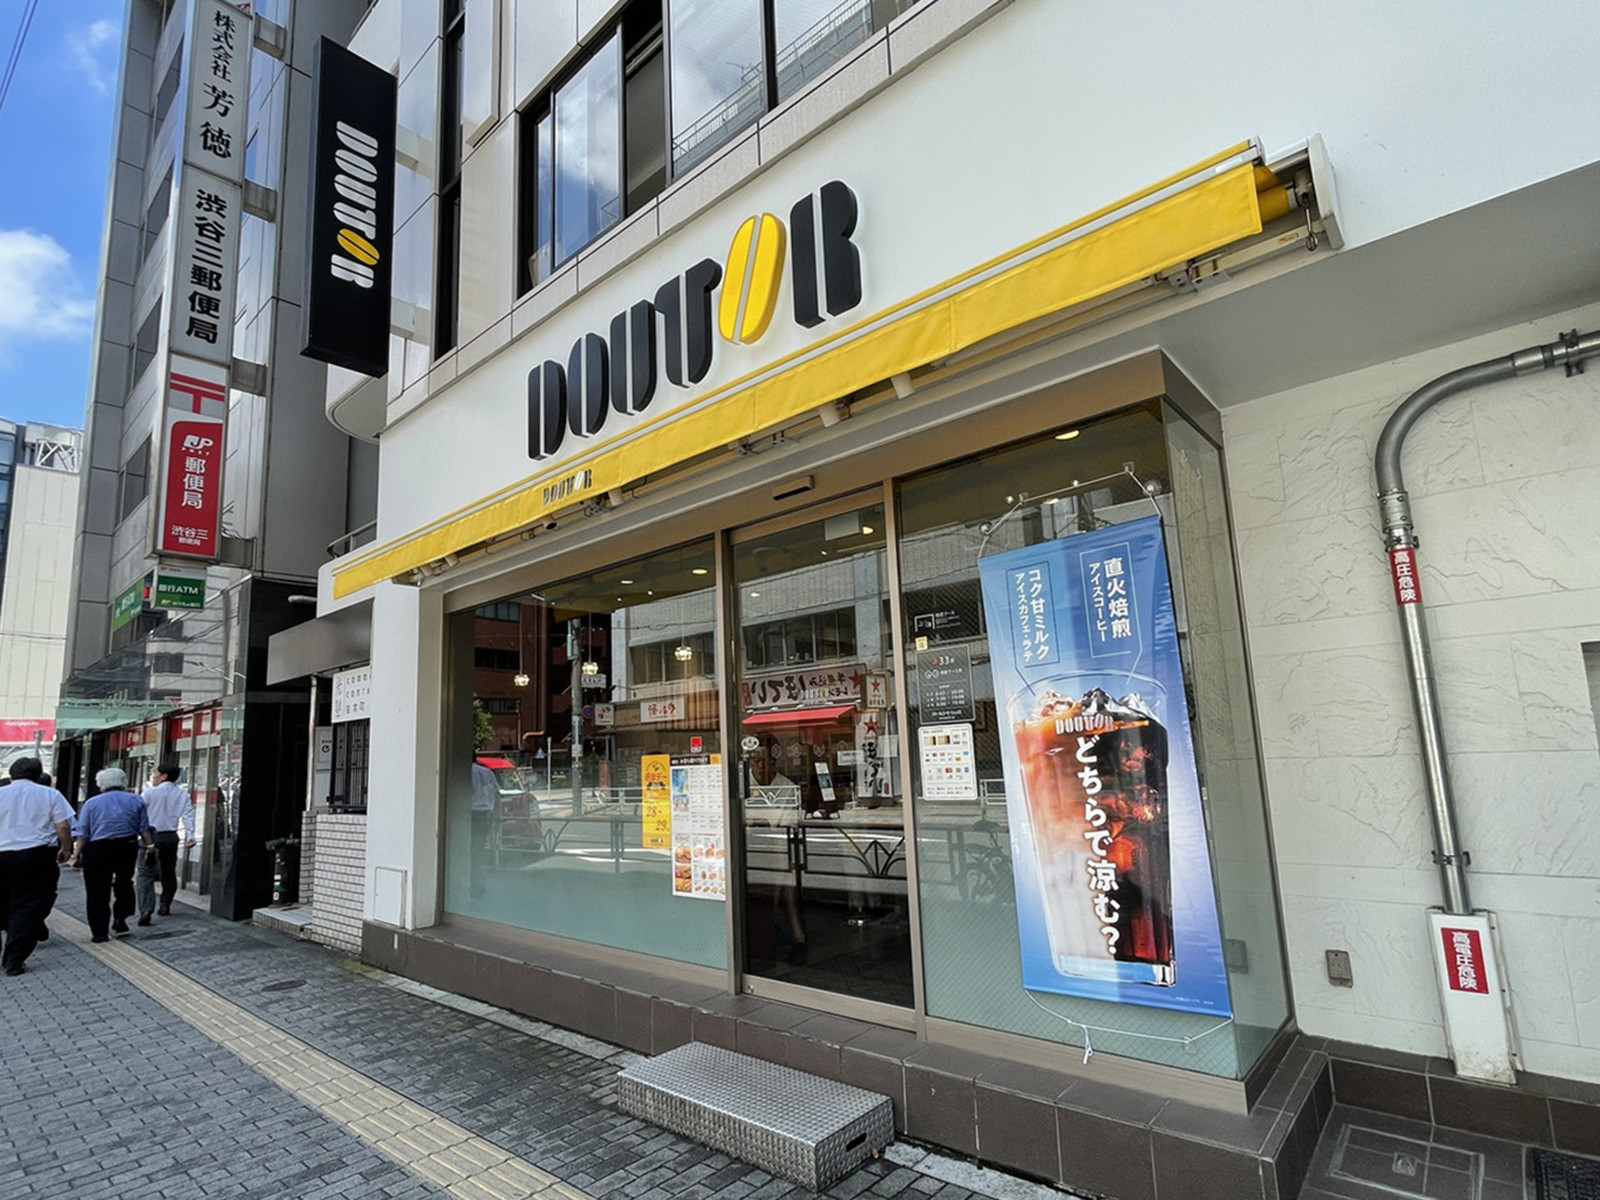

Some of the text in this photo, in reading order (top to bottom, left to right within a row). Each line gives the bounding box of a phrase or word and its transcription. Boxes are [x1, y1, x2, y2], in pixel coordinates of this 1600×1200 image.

[331, 120, 380, 289] DOUTOR
[185, 188, 228, 345] 渋谷三郵便局
[528, 179, 863, 461] DOUTOR
[181, 456, 206, 510] 郵便局
[543, 469, 592, 507] DOUTOR
[170, 524, 209, 540] 渋谷三
[1014, 572, 1034, 663] アイスカフェ・ラテ
[1028, 568, 1050, 661] コク甘ミルク
[1089, 562, 1108, 642] アイスコーヒー
[1103, 556, 1131, 639] 直火焙煎
[1393, 550, 1417, 602] 高圧危険
[1055, 713, 1114, 735] DOUTOR
[1075, 735, 1122, 954] どちらで涼む?
